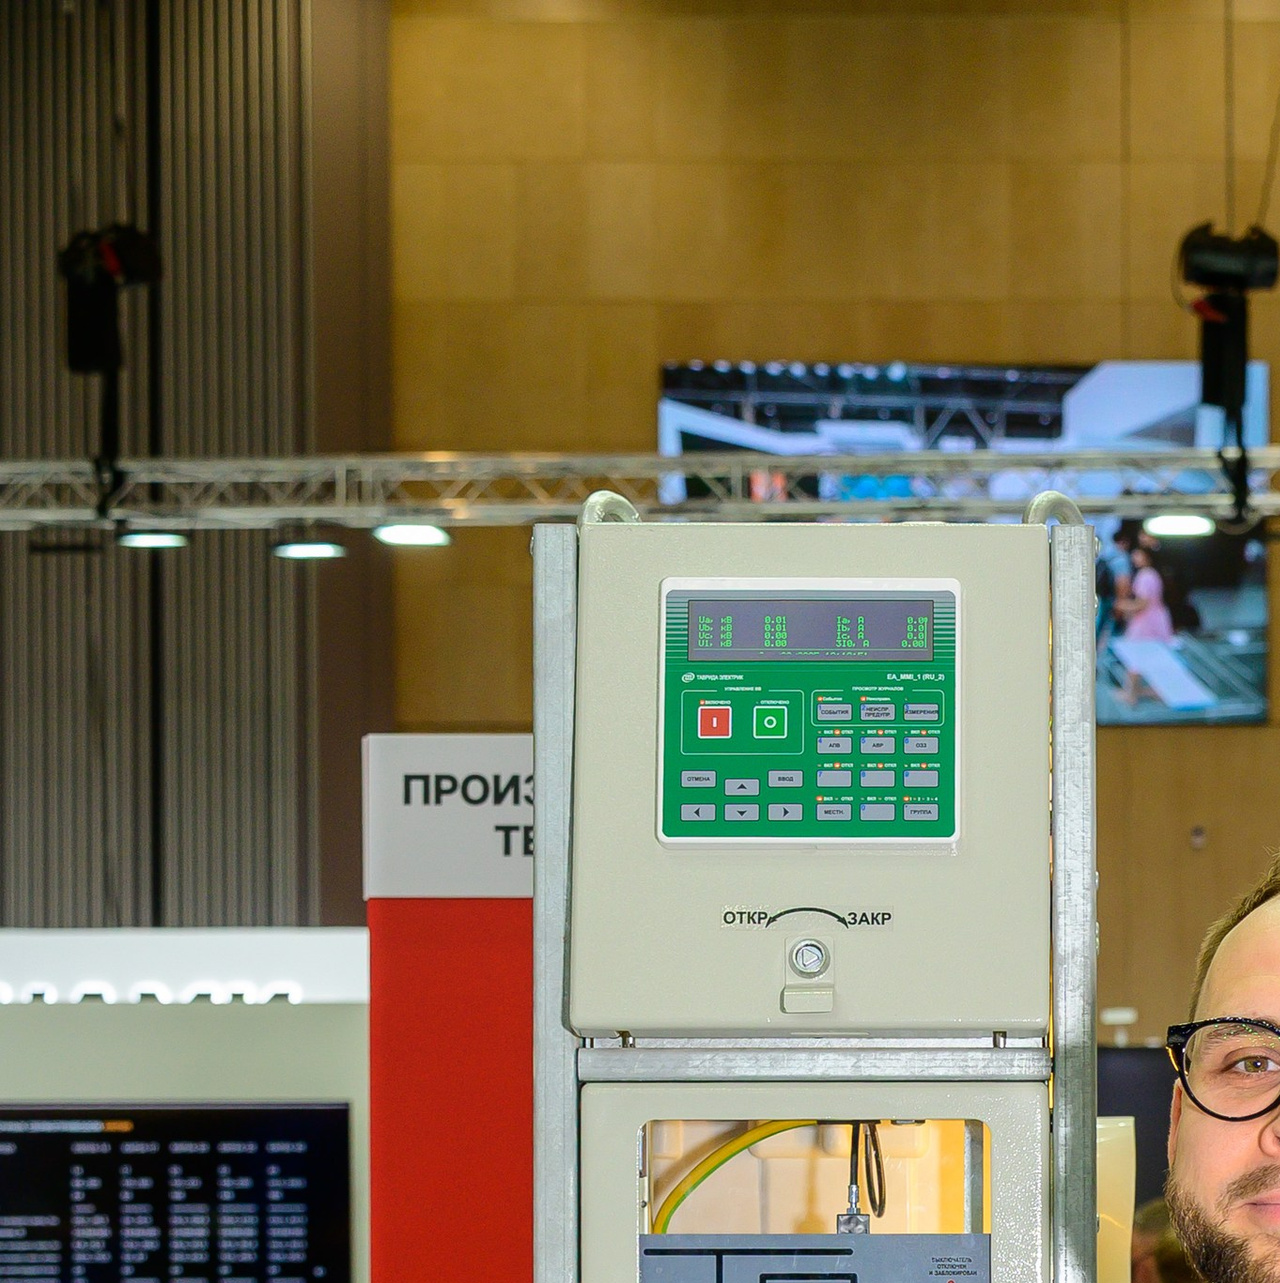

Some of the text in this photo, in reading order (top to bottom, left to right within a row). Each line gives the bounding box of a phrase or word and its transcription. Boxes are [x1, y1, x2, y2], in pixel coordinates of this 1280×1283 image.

[764, 616, 786, 624] 0.01
[764, 632, 787, 640] 0.00
[764, 640, 787, 648] 0.00
[723, 910, 768, 926] ОТКР
[847, 910, 892, 926] ЗАКР
